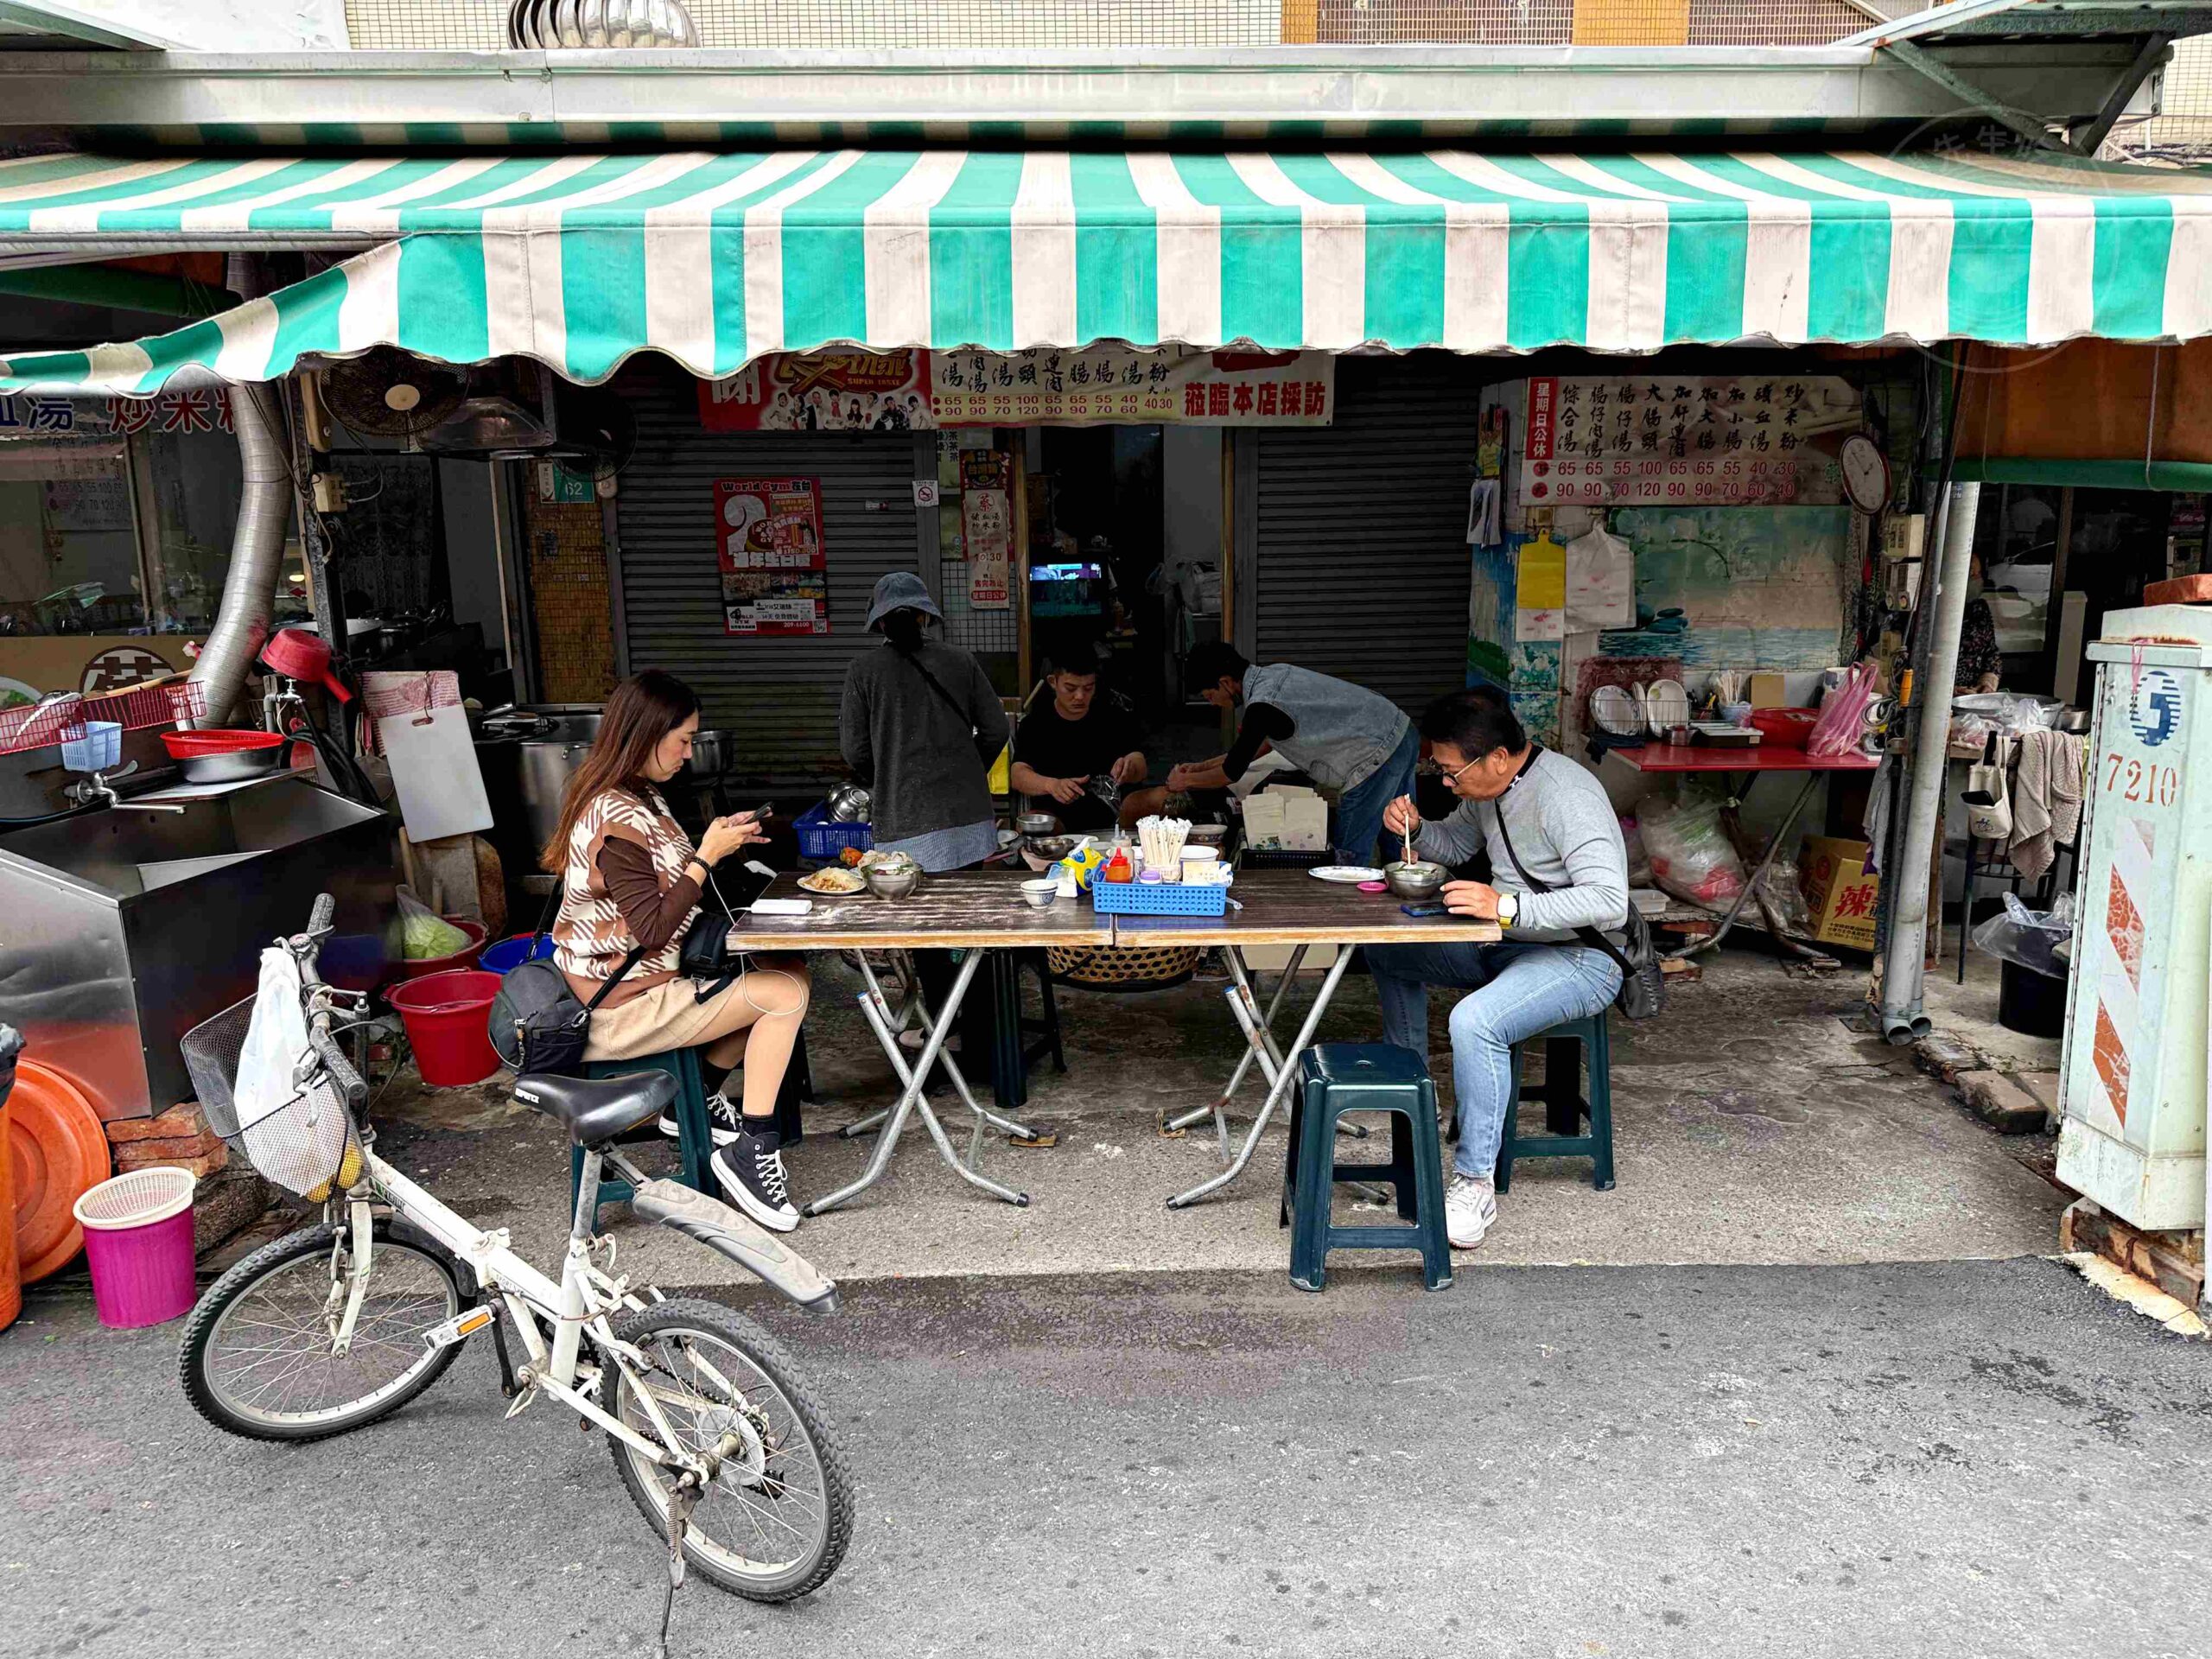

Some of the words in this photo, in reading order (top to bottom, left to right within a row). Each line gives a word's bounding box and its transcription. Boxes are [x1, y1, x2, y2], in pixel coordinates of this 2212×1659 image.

[944, 397, 962, 405] 65
[969, 397, 987, 405] 65
[993, 396, 1011, 405] 55
[1015, 396, 1039, 404] 100
[1045, 395, 1063, 404] 65
[1070, 395, 1087, 404] 65
[1095, 395, 1113, 404] 55
[1121, 395, 1138, 404] 40
[1145, 398, 1158, 410] 40
[1160, 398, 1173, 410] 30
[1185, 382, 1325, 416] 蒞臨本店採訪
[944, 407, 963, 416] 90
[969, 407, 987, 416] 90
[994, 406, 1011, 416] 70
[1017, 406, 1039, 415] 120
[1045, 406, 1063, 415] 90
[1070, 405, 1087, 415] 90
[1096, 405, 1113, 414] 70
[1121, 405, 1138, 414] 60
[1779, 384, 1806, 452] 炒米粉
[1533, 382, 1550, 457] 星期日公休
[1557, 384, 1581, 454] 綜合湯
[1585, 384, 1609, 460] 腸仔肉湯
[1612, 384, 1637, 454] 腸仔湯
[1558, 461, 1576, 475] 65
[1586, 461, 1603, 475] 65
[1613, 461, 1630, 475] 55
[1639, 461, 1662, 475] 100
[1669, 461, 1687, 475] 65
[1696, 461, 1714, 475] 65
[1723, 461, 1740, 474] 55
[1750, 461, 1767, 475] 40
[1778, 461, 1796, 475] 30
[565, 481, 584, 497] 62
[721, 481, 761, 493] World
[761, 481, 791, 493] Gym
[1556, 483, 1574, 497] 90
[1584, 483, 1602, 497] 90
[1612, 483, 1629, 497] 70
[1637, 482, 1661, 497] 120
[1668, 482, 1686, 497] 90
[1695, 482, 1713, 497] 90
[1722, 482, 1739, 497] 70
[1748, 482, 1765, 497] 60
[1777, 482, 1795, 497] 40
[974, 552, 1001, 562] 10:30
[972, 591, 1006, 600] 星期日公休
[2107, 753, 2177, 807] 7210
